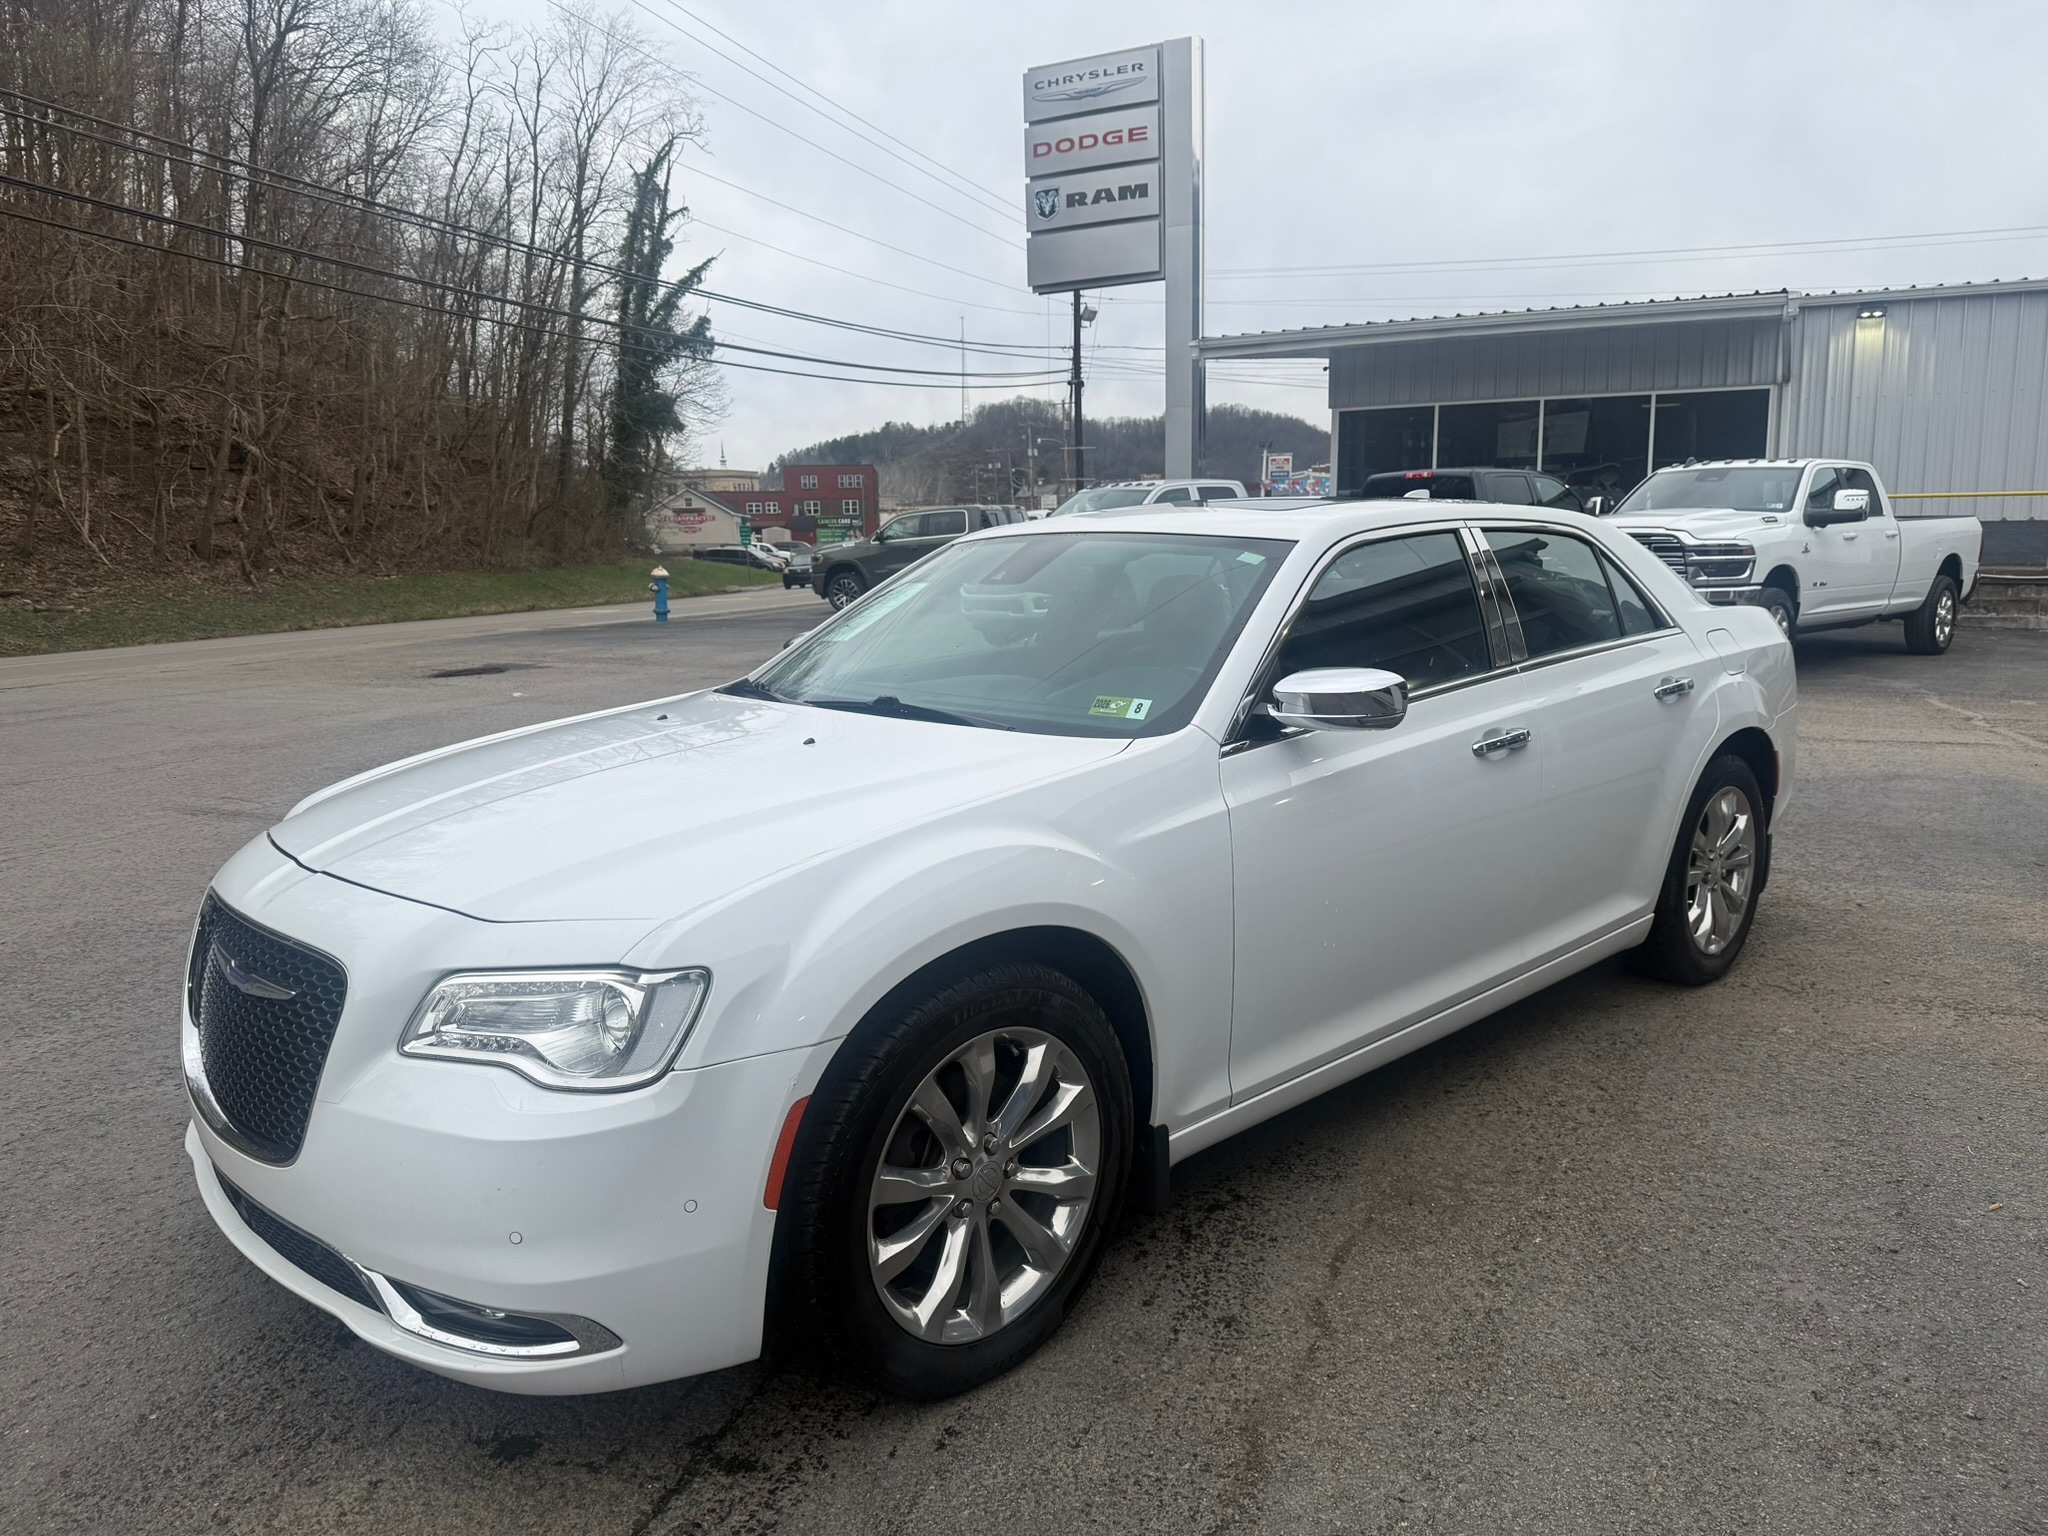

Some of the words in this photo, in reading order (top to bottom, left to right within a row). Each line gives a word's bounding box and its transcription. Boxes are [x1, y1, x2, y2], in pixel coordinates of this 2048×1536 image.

[1034, 62, 1145, 91] CHRYSLER
[1032, 125, 1148, 159] DODGE
[1066, 182, 1149, 209] RAM
[1134, 702, 1143, 713] 8
